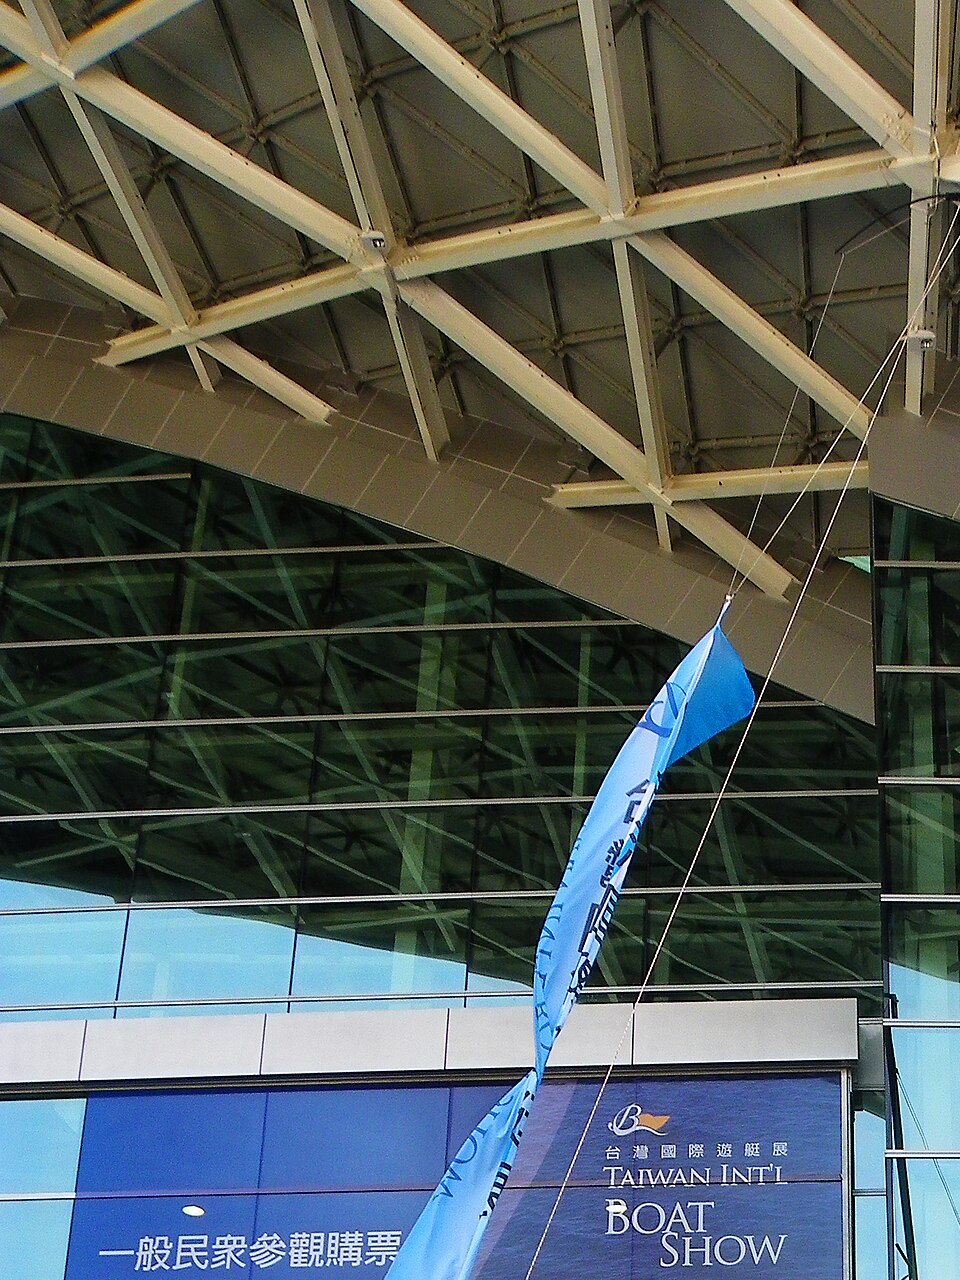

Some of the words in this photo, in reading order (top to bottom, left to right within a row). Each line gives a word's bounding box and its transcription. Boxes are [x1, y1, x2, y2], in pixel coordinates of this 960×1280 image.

[605, 1142, 788, 1160] 台灣國際遊艇展
[603, 1166, 711, 1189] TAIWAN
[721, 1163, 788, 1186] INT'L
[605, 1198, 715, 1235] BOAT
[660, 1232, 788, 1268] SHOW
